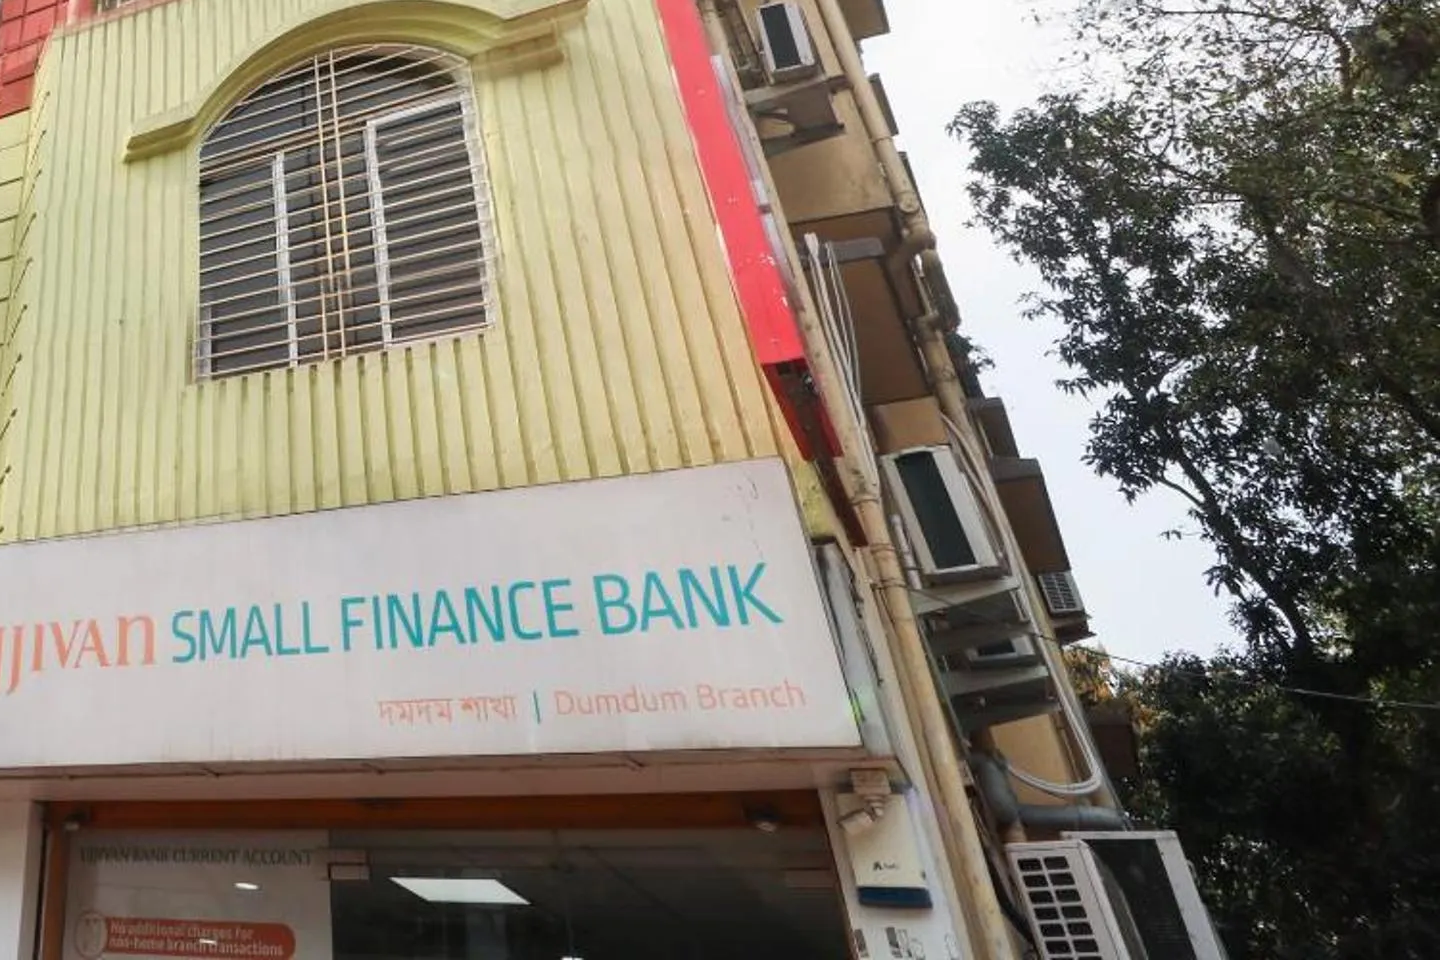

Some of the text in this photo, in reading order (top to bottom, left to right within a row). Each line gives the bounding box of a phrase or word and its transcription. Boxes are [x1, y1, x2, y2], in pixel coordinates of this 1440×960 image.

[171, 600, 329, 663] SMALL
[340, 578, 579, 652] FINANCE
[593, 562, 784, 635] BANK
[553, 678, 807, 717] Dumdum Branch
[243, 848, 312, 866] ACCOUNT
